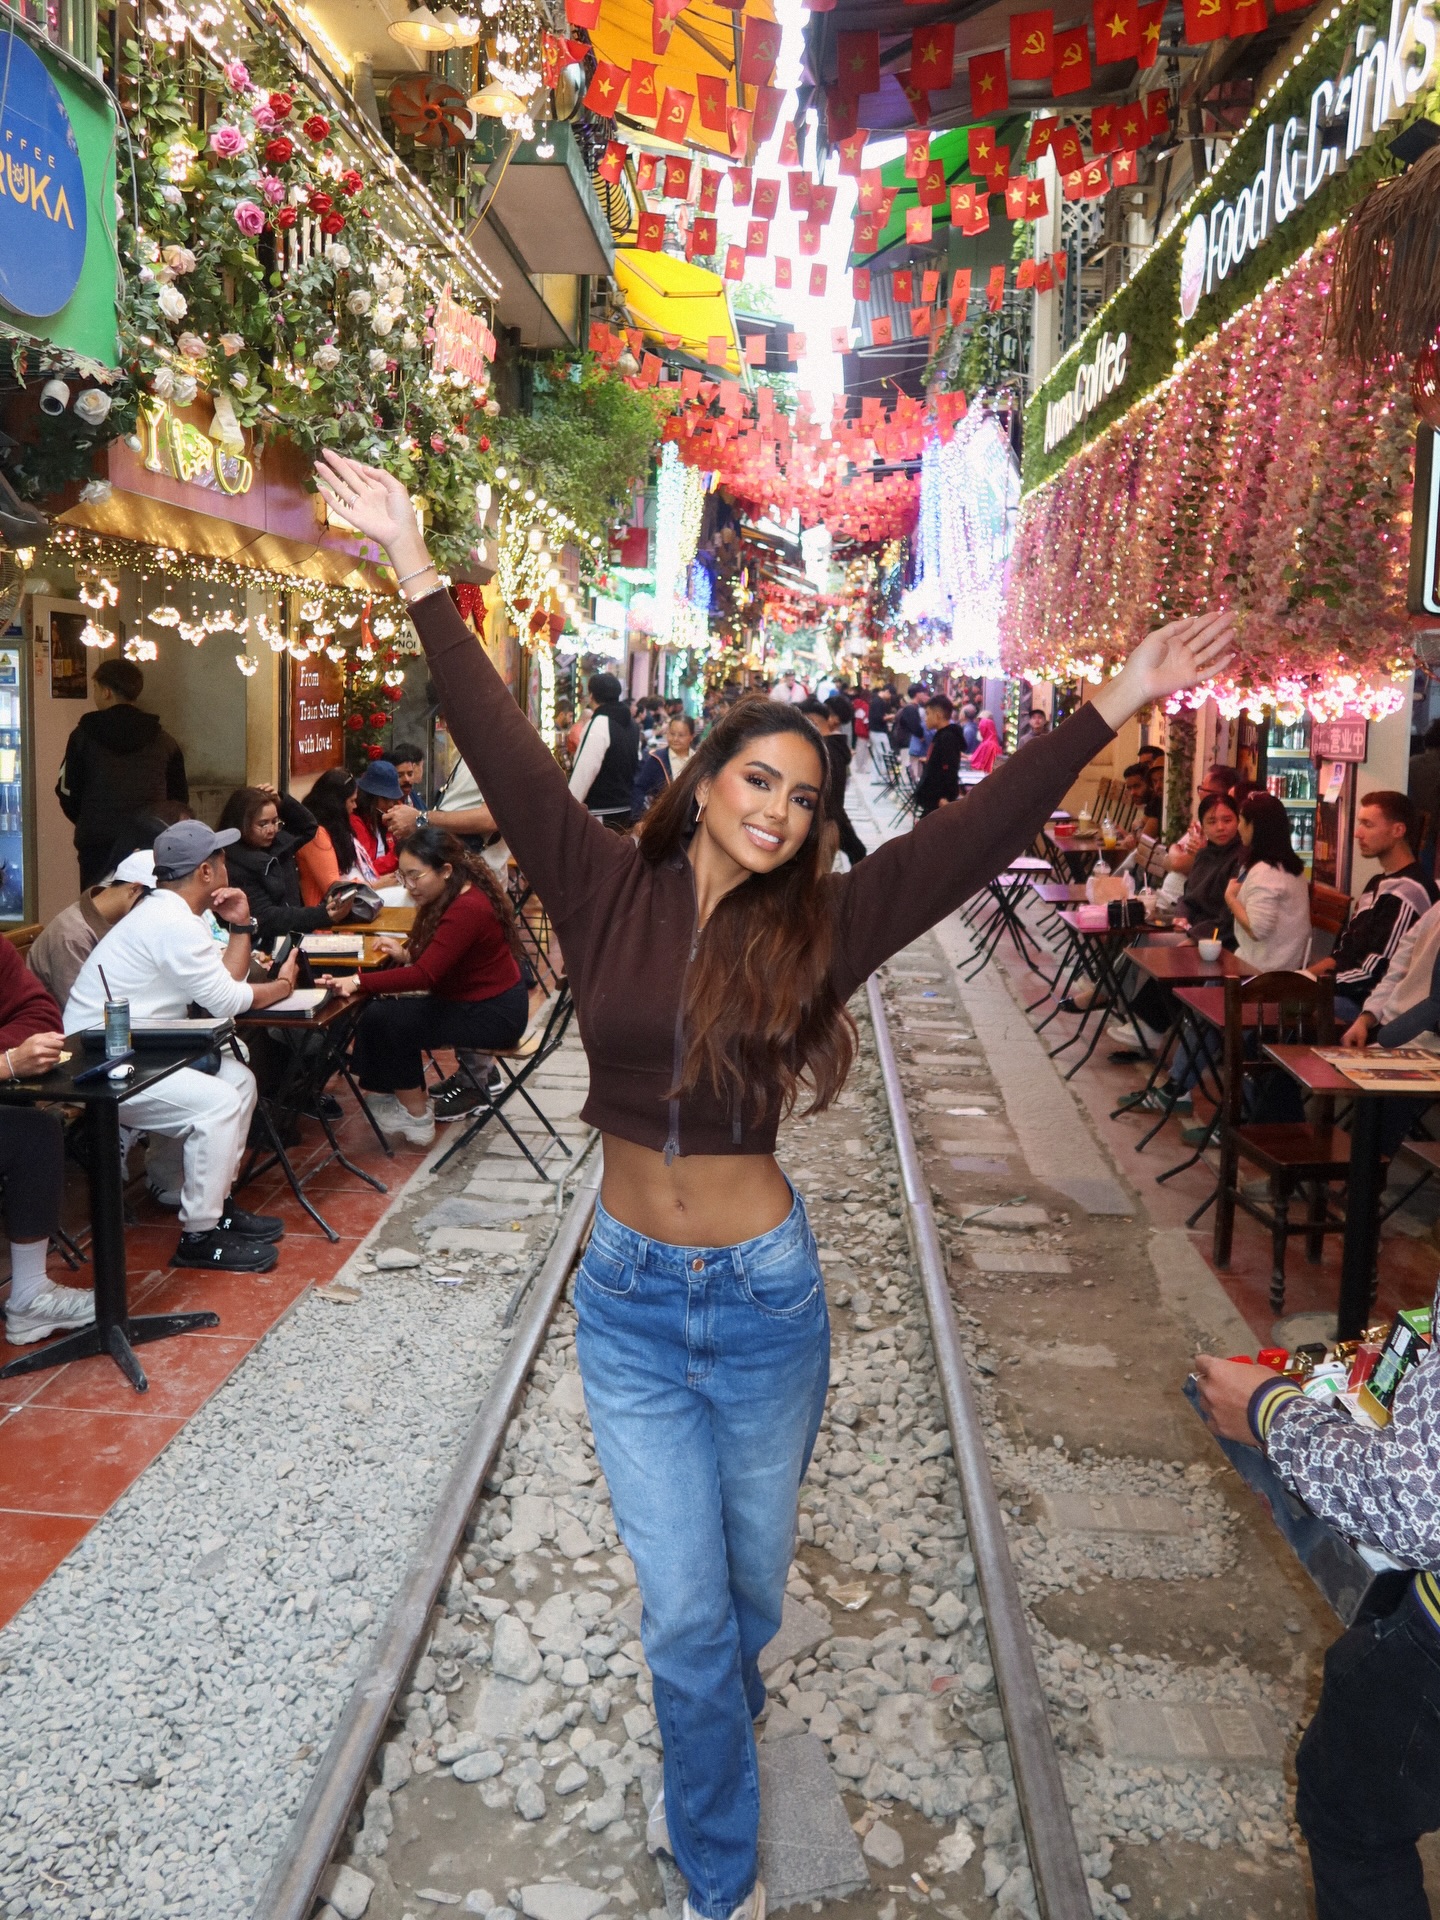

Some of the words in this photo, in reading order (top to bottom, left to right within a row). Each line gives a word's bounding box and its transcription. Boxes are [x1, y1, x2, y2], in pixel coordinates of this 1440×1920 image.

[1206, 124, 1275, 294] Food
[1275, 117, 1297, 223] &
[1074, 331, 1127, 422] Coffee
[300, 666, 319, 687] From
[300, 701, 318, 721] Train
[320, 699, 340, 718] Street
[298, 735, 315, 754] with
[316, 731, 333, 752] love!
[1330, 727, 1364, 754] 营业中
